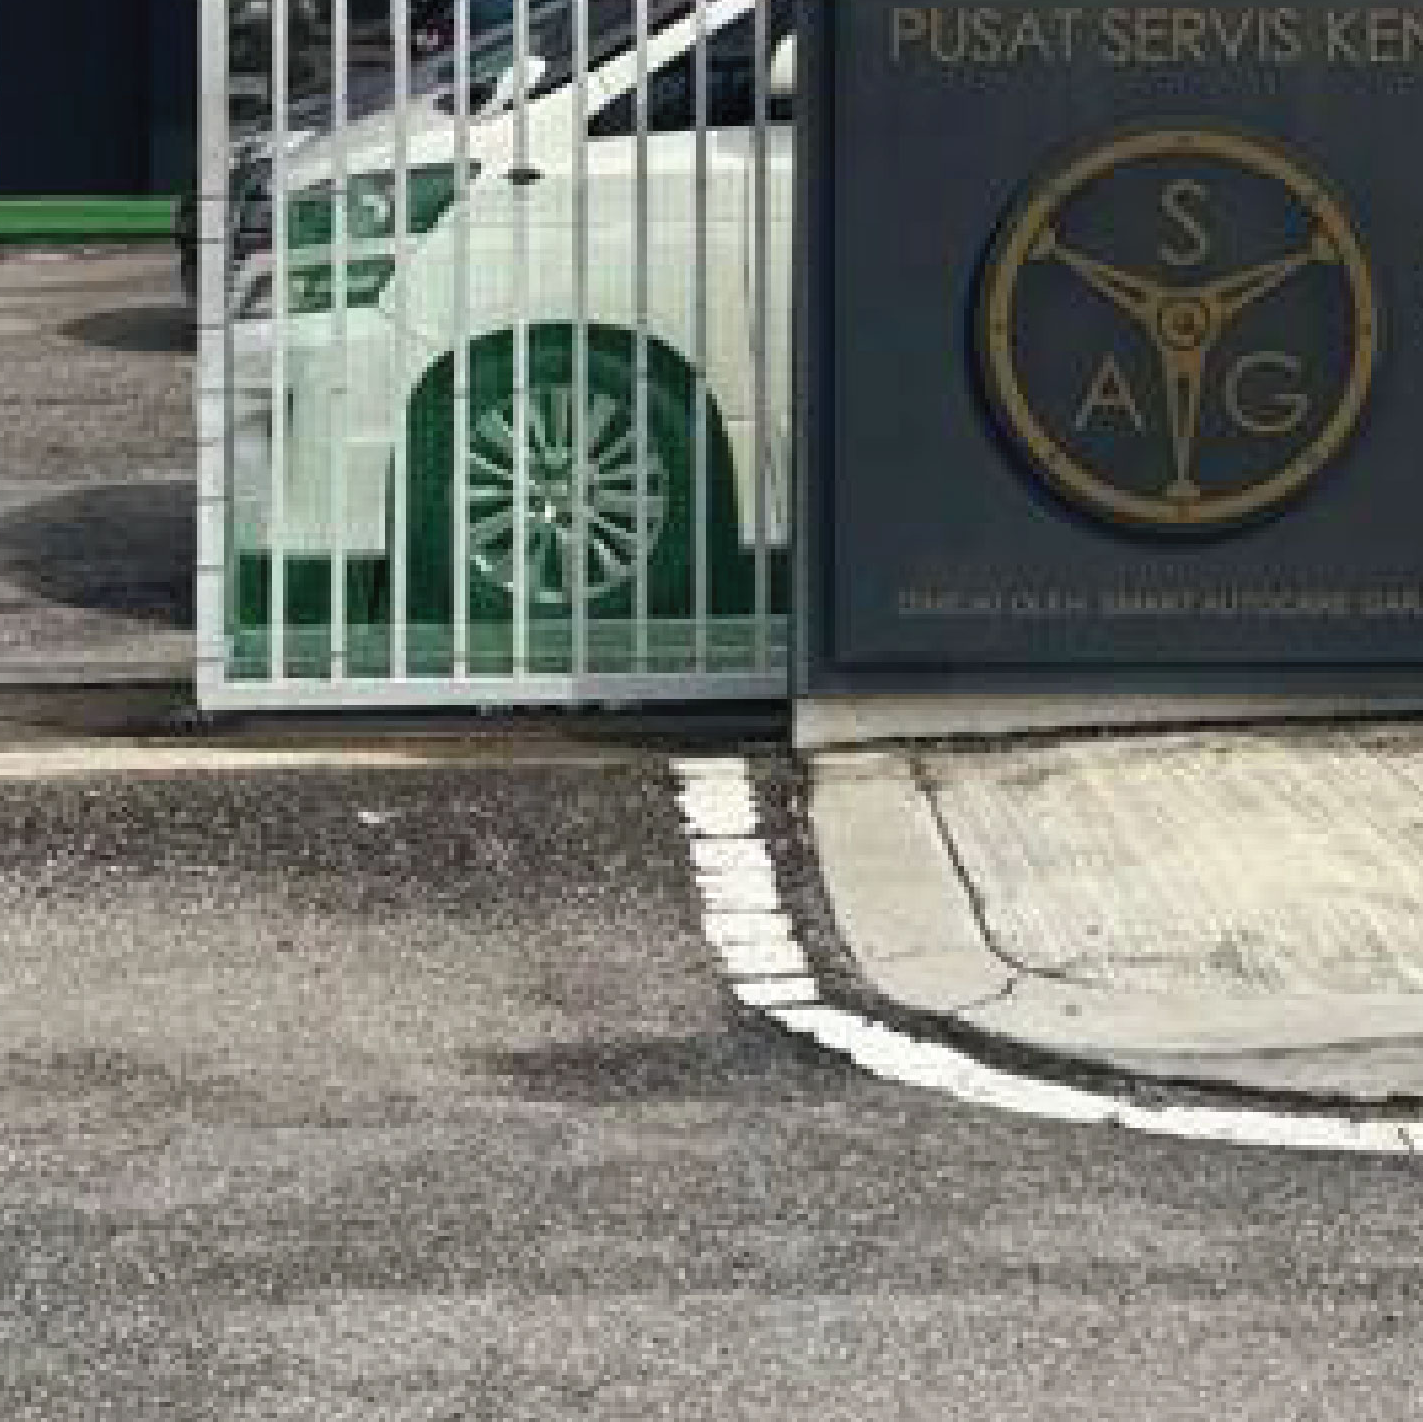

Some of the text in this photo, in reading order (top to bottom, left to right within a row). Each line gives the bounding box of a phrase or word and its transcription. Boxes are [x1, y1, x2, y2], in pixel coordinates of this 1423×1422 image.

[893, 7, 1082, 61] PUSAT
[1101, 7, 1303, 61] SERVIS
[1158, 181, 1212, 266] S
[1074, 351, 1309, 434] A G
